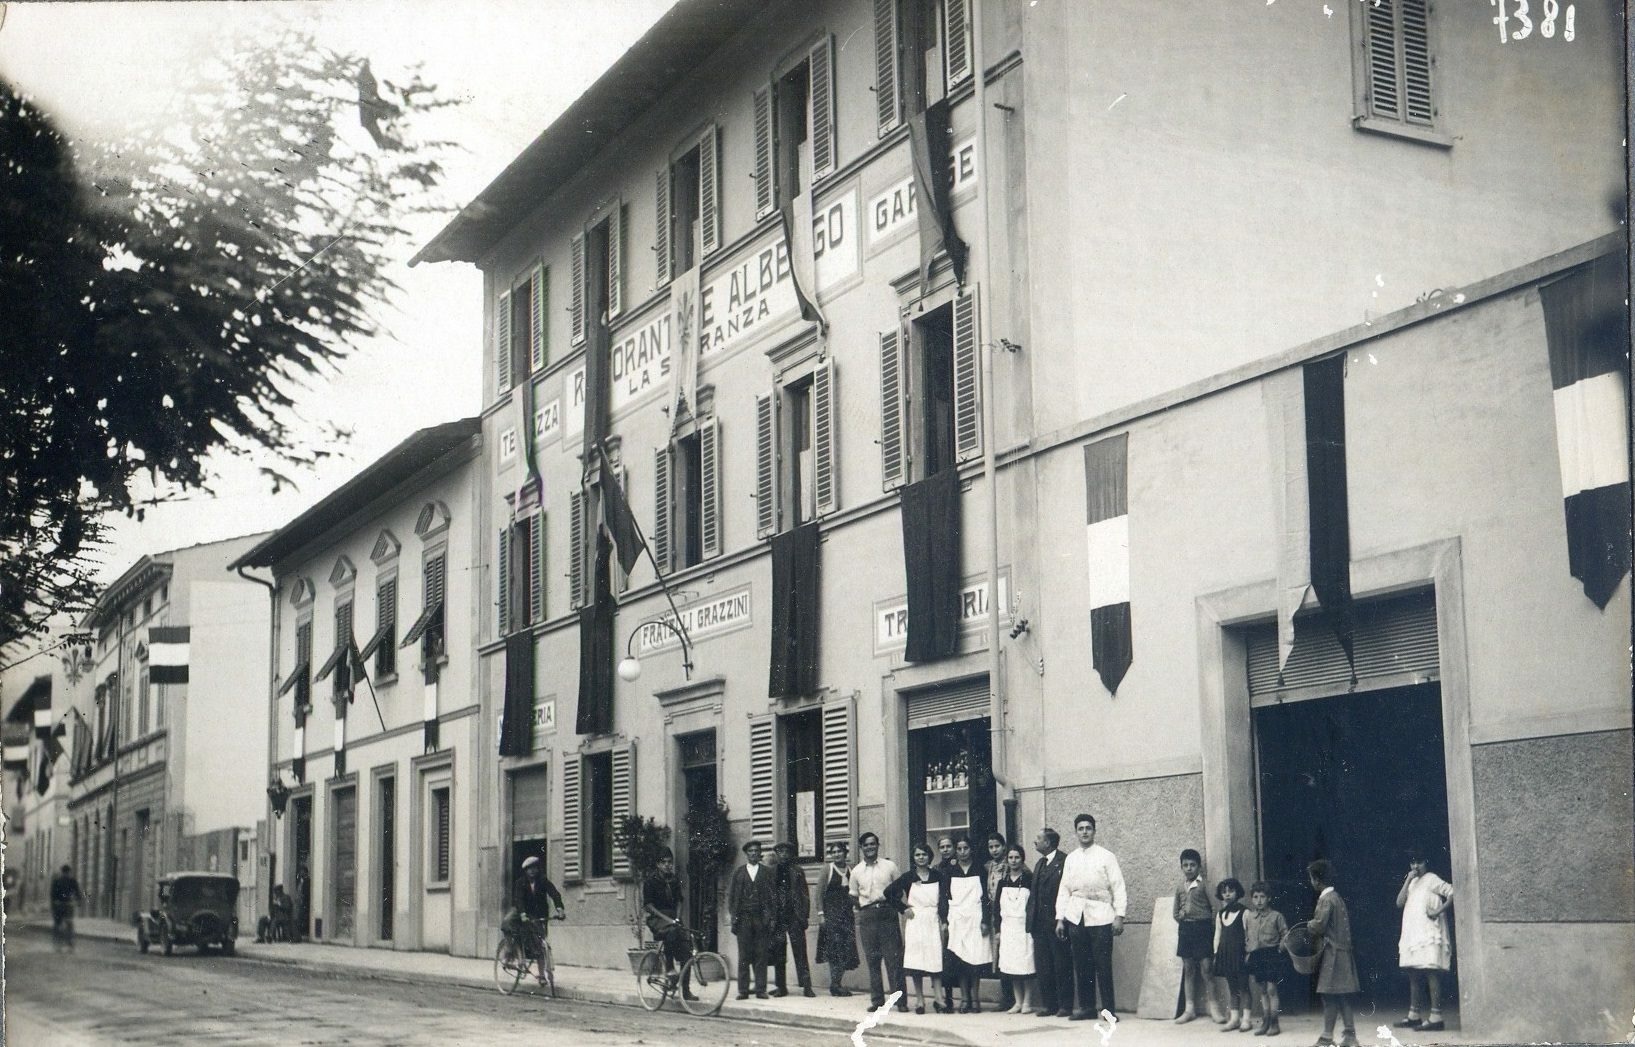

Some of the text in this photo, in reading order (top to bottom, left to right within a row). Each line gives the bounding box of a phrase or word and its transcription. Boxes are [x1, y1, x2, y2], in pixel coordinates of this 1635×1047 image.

[728, 202, 844, 314] ALBEGO
[629, 298, 771, 396] LA SRANZA
[502, 404, 558, 457] TEZZA
[697, 594, 748, 629] GRAZZINI
